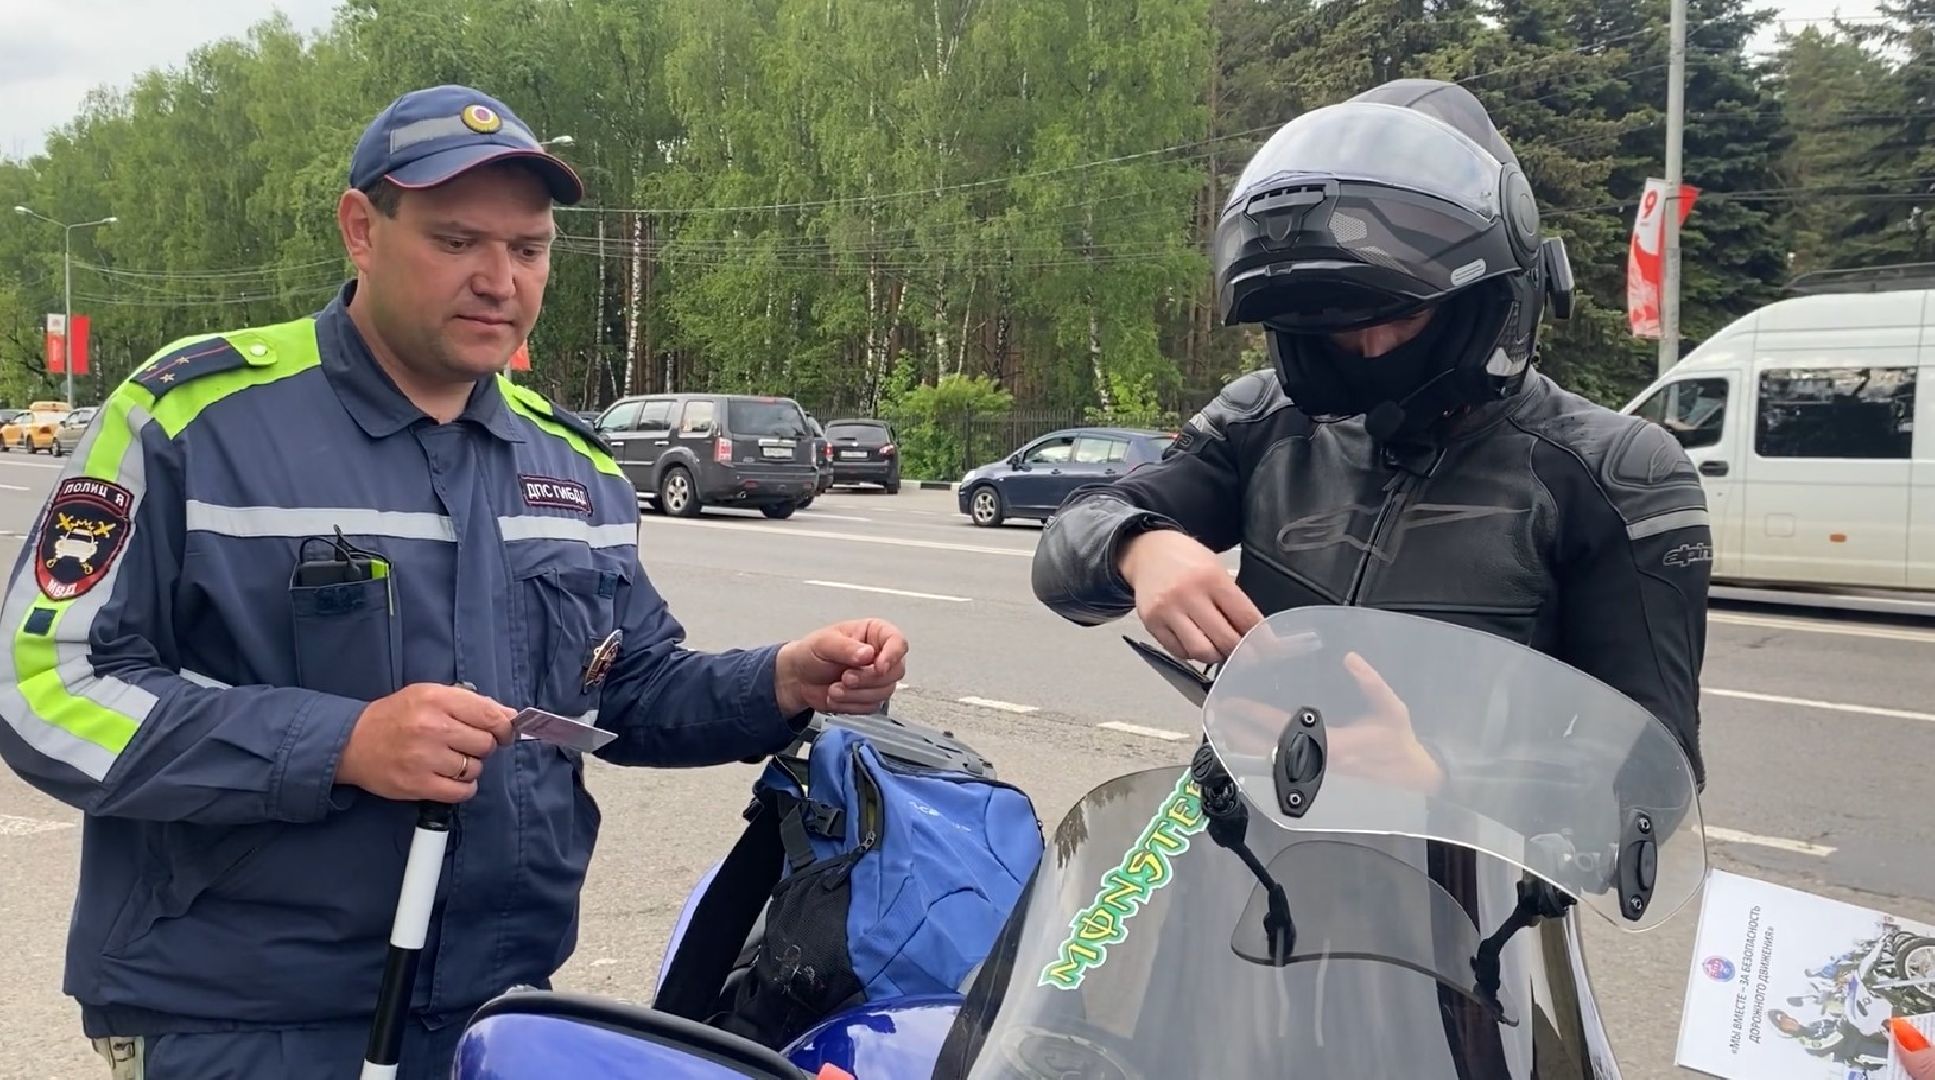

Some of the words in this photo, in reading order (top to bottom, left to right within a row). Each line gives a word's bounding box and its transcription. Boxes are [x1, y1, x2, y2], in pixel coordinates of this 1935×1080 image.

[1643, 190, 1658, 219] 9
[526, 484, 553, 499] ДПС
[553, 485, 587, 505] ГИБДД
[47, 579, 78, 597] МВД
[1741, 905, 1761, 973] БЕЗОПАСНОСТЬ
[1740, 974, 1750, 986] ЗА
[1733, 993, 1747, 1030] ВМЕСТЕ
[1749, 983, 1766, 1044] ДОРОЖНОГО
